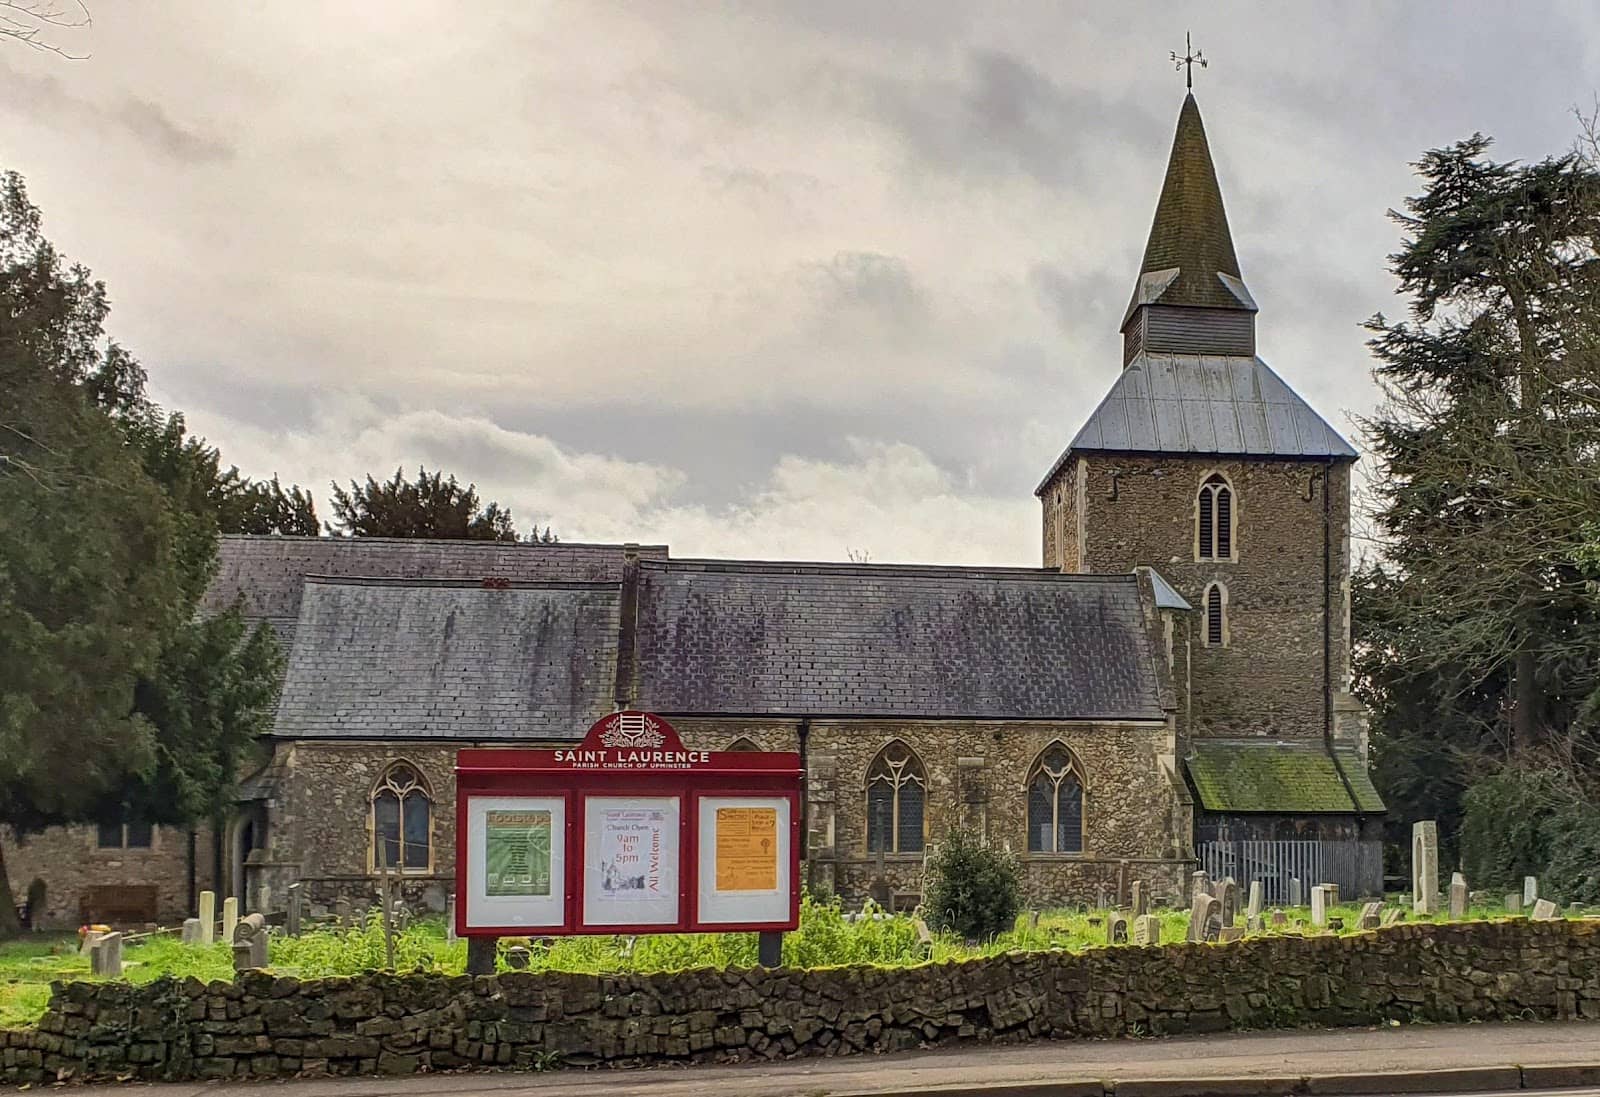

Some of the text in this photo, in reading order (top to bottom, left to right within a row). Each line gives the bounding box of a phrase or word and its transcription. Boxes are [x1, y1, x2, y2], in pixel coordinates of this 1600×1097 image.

[554, 751, 710, 763] SAINT LAURENCE
[616, 834, 639, 843] 9am
[623, 843, 633, 852] to
[649, 827, 660, 874] Welcome
[615, 853, 639, 865] 5pm
[649, 876, 660, 893] All
